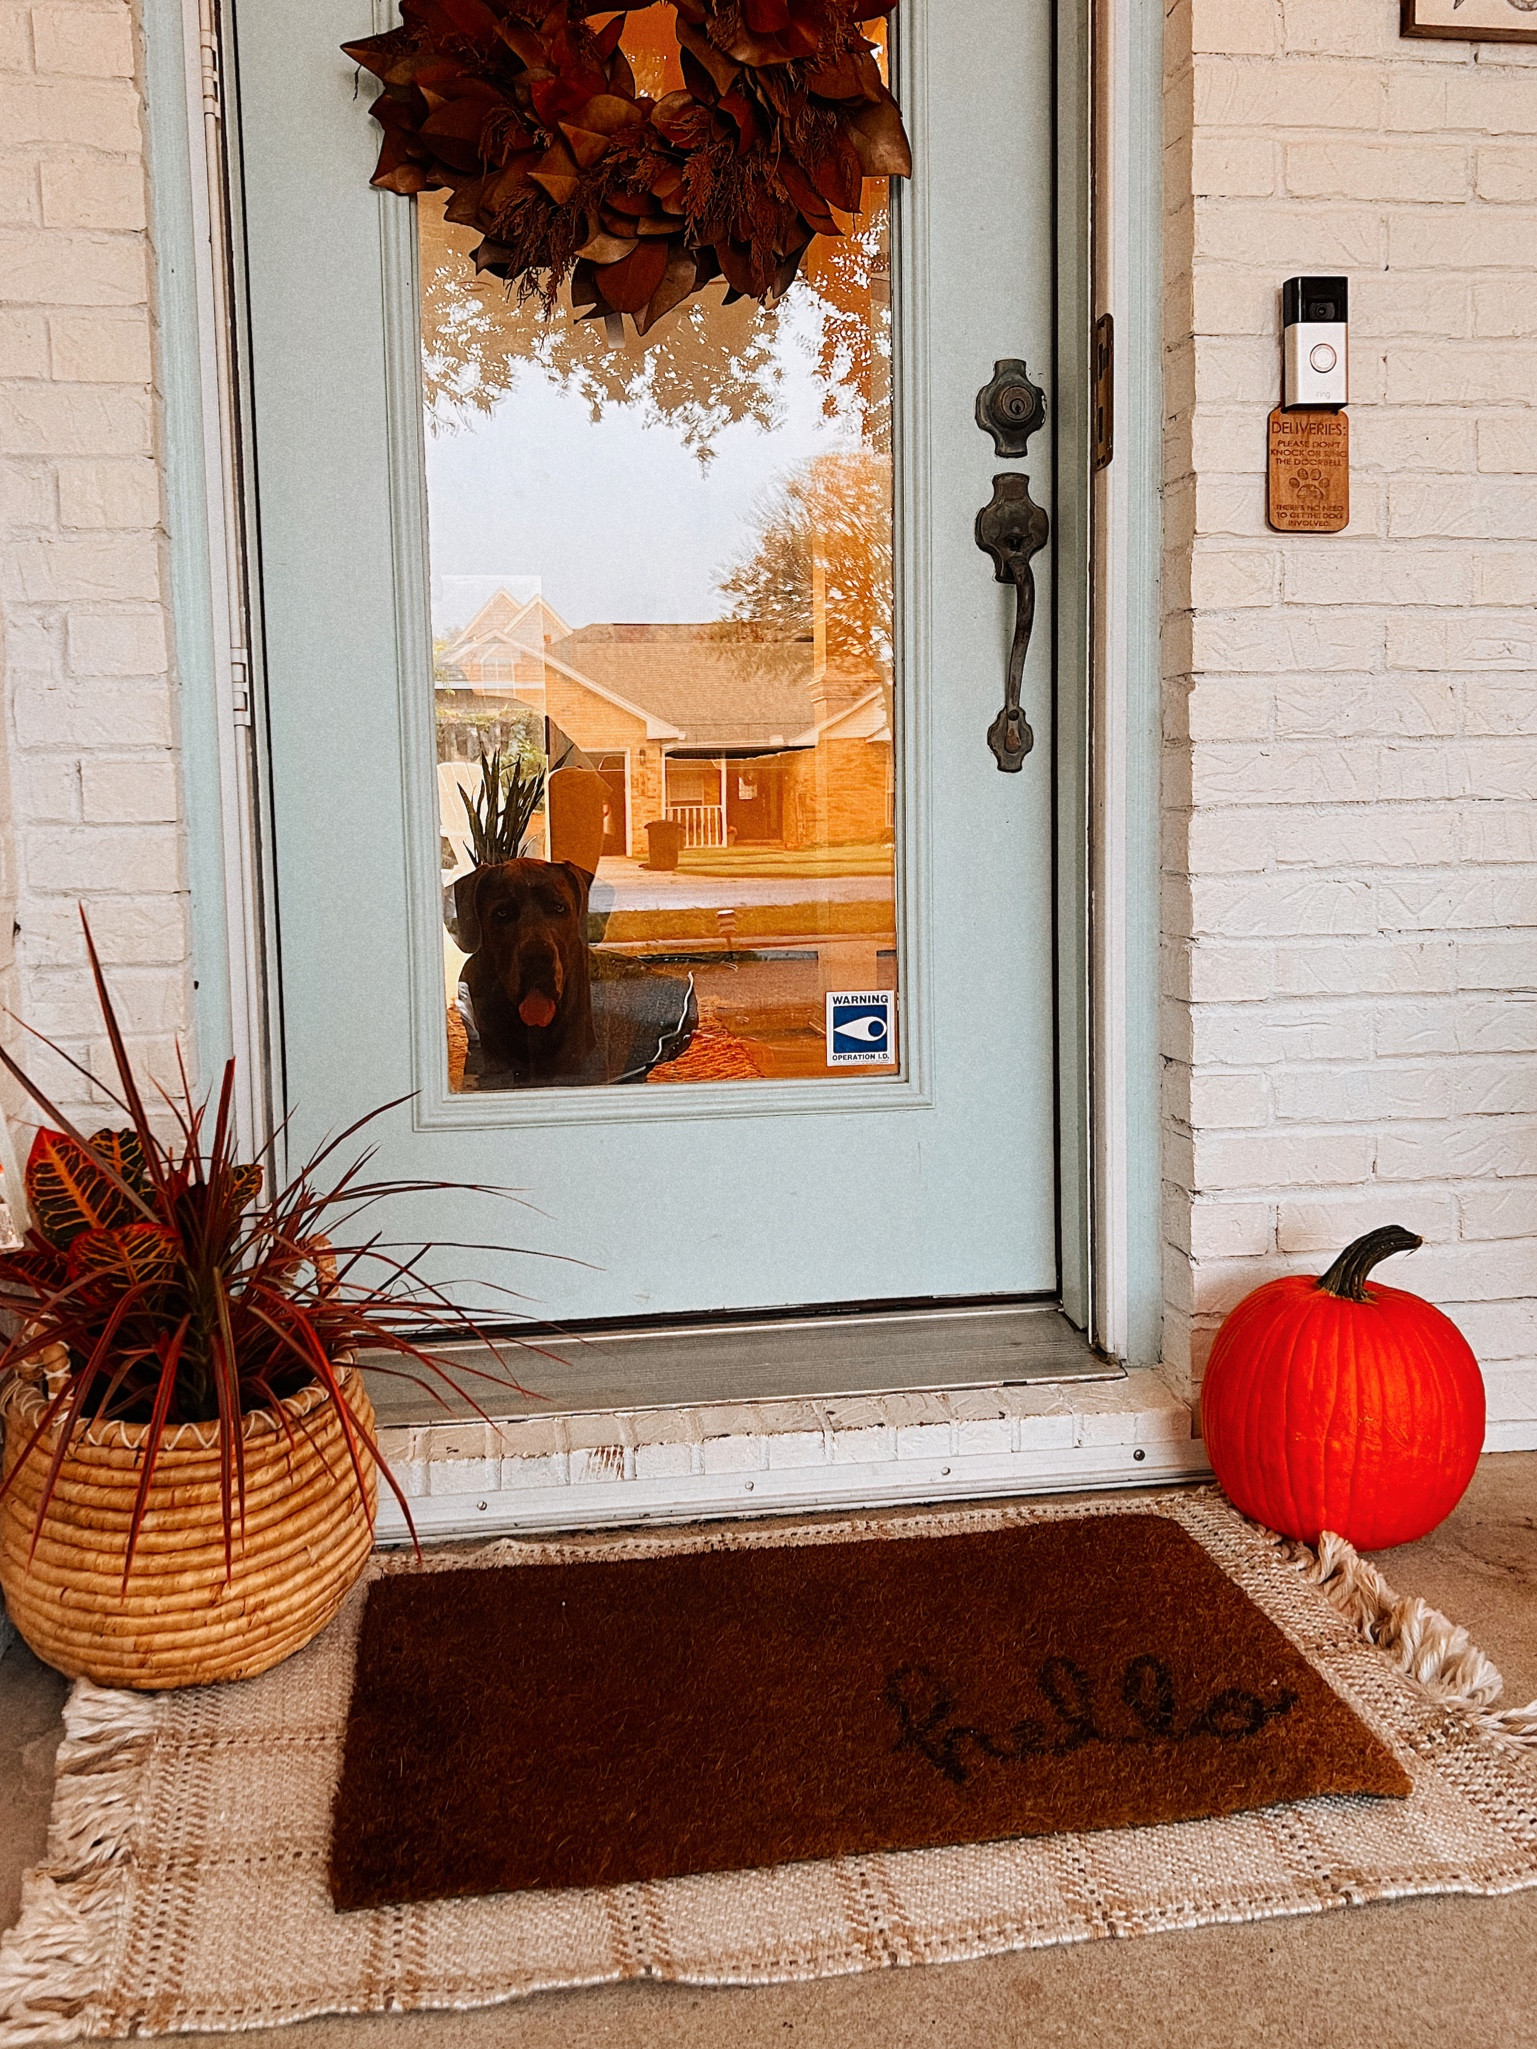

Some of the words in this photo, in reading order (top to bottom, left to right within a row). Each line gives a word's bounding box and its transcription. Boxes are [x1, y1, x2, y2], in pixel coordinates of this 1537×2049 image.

[1316, 390, 1331, 400] ring
[1271, 421, 1347, 436] DELIVERIES:
[1277, 440, 1310, 448] PLEASE
[1270, 448, 1305, 457] KNOCK
[1307, 449, 1321, 457] OR
[1275, 457, 1292, 466] THE
[1293, 458, 1343, 467] DOORBELL
[1276, 511, 1288, 519] TO
[832, 994, 889, 1005] WARNING
[832, 1053, 876, 1061] OPERATION
[885, 1653, 1299, 1784] hello
